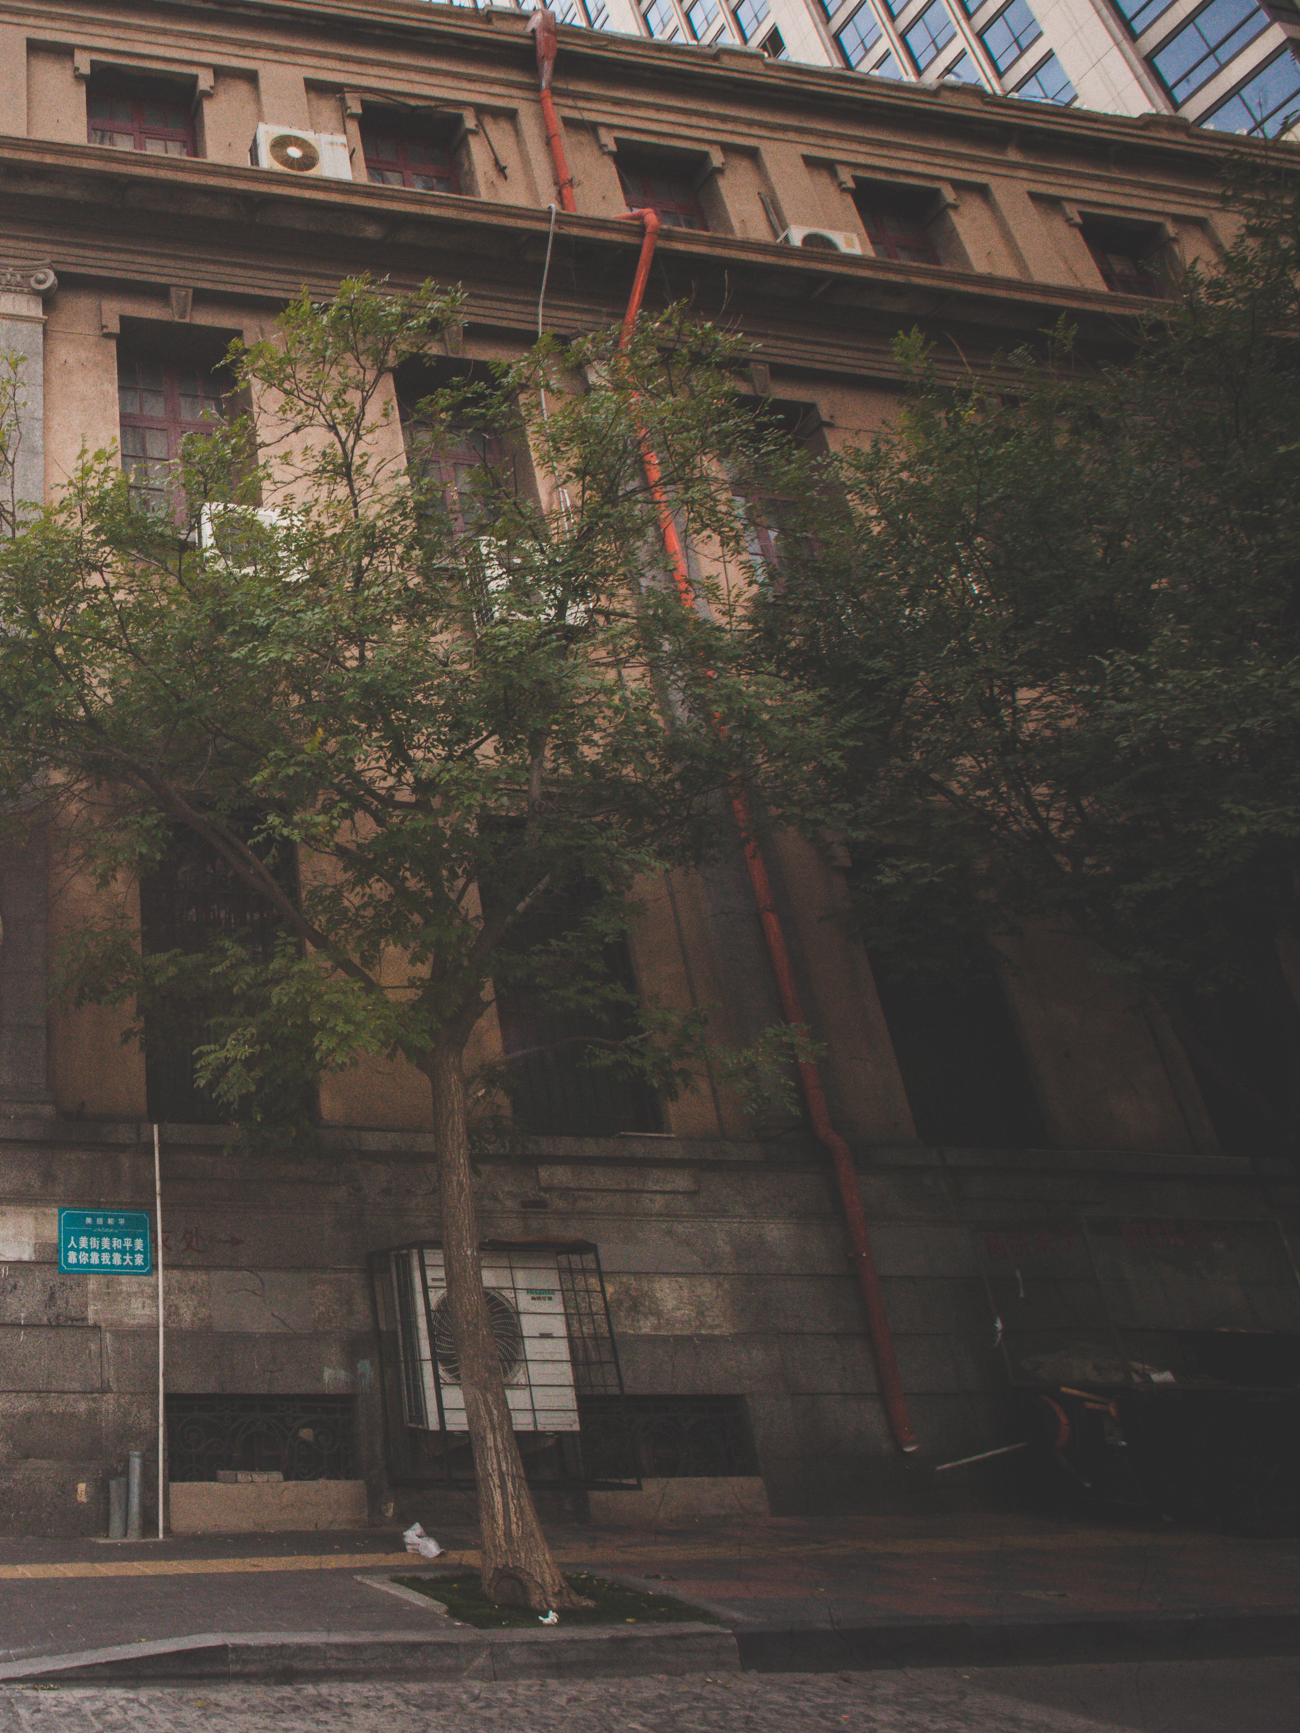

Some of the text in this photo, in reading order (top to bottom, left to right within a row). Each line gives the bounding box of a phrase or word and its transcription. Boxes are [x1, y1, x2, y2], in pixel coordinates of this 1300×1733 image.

[67, 1235, 144, 1252] 人美街美和平美
[67, 1250, 145, 1267] 靠你靠我靠大家
